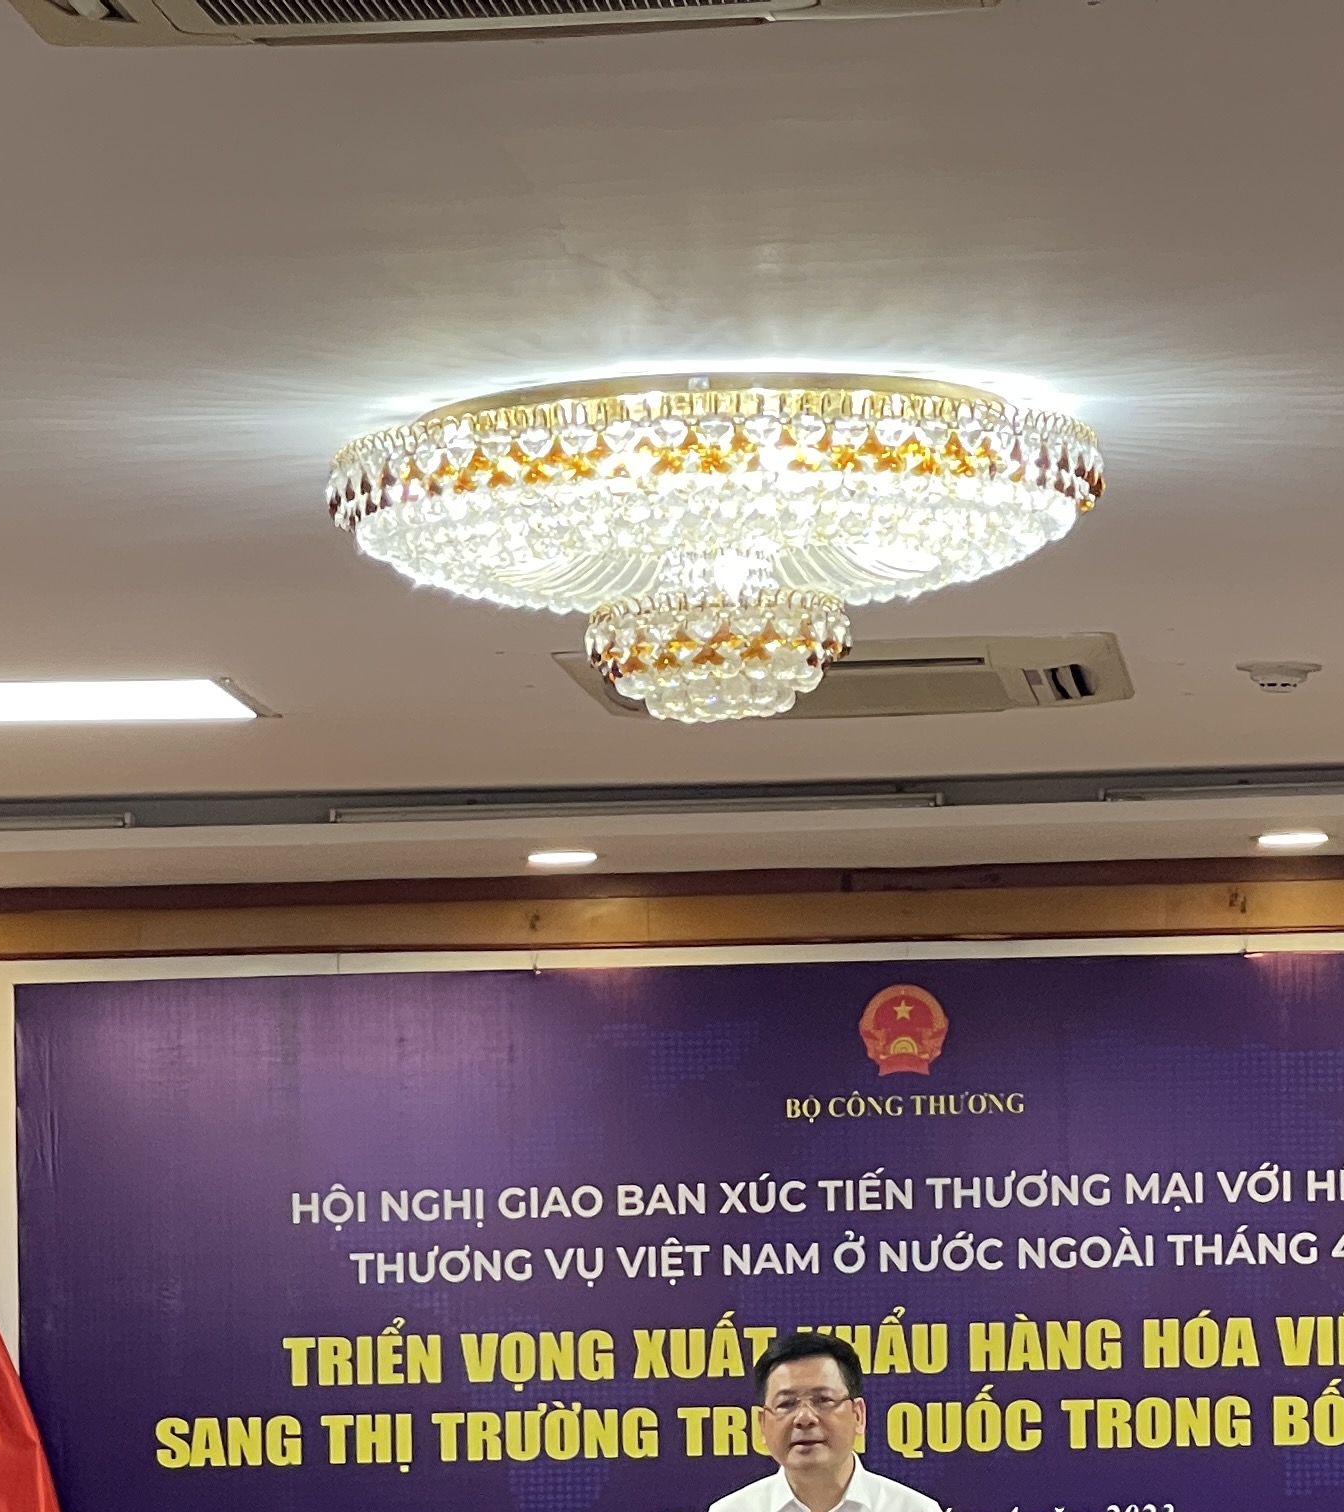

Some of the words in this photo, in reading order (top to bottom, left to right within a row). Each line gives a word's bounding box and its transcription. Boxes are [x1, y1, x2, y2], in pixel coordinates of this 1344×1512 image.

[786, 1095, 822, 1124] BỘ
[828, 1090, 903, 1118] CÔNG
[909, 1091, 1024, 1116] THƯƠNG
[292, 1183, 366, 1232] HỘI
[381, 1188, 484, 1228] NGHỊ
[498, 1185, 603, 1220] GIAO
[617, 1182, 706, 1217] BAN
[719, 1172, 807, 1214] XÚC
[817, 1167, 913, 1212] TIẾN
[925, 1169, 1111, 1209] THƯƠNG
[1125, 1171, 1204, 1213] MẠI
[1216, 1162, 1291, 1203] VỚI
[349, 1244, 533, 1284] THƯƠNG
[544, 1247, 604, 1288] VỤ
[615, 1237, 711, 1286] VIỆT
[723, 1242, 819, 1276] NAM
[833, 1230, 866, 1274] Ở
[879, 1230, 1004, 1273] NƯỚC
[1018, 1227, 1154, 1270] NGOÀI
[1166, 1224, 1318, 1266] THÁNG
[282, 1316, 442, 1387] TRIỂN
[460, 1329, 615, 1392] VỌNG
[632, 1310, 778, 1379] XUẤT
[796, 1306, 948, 1375] HẨU
[969, 1313, 1122, 1372] HÀNG
[1143, 1309, 1258, 1369] HÓA
[155, 1415, 302, 1469] SANG
[320, 1413, 413, 1473] THỊ
[431, 1400, 659, 1462] TRƯỜNG
[886, 1384, 1042, 1459] QUỐC
[1060, 1395, 1252, 1450] TRONG
